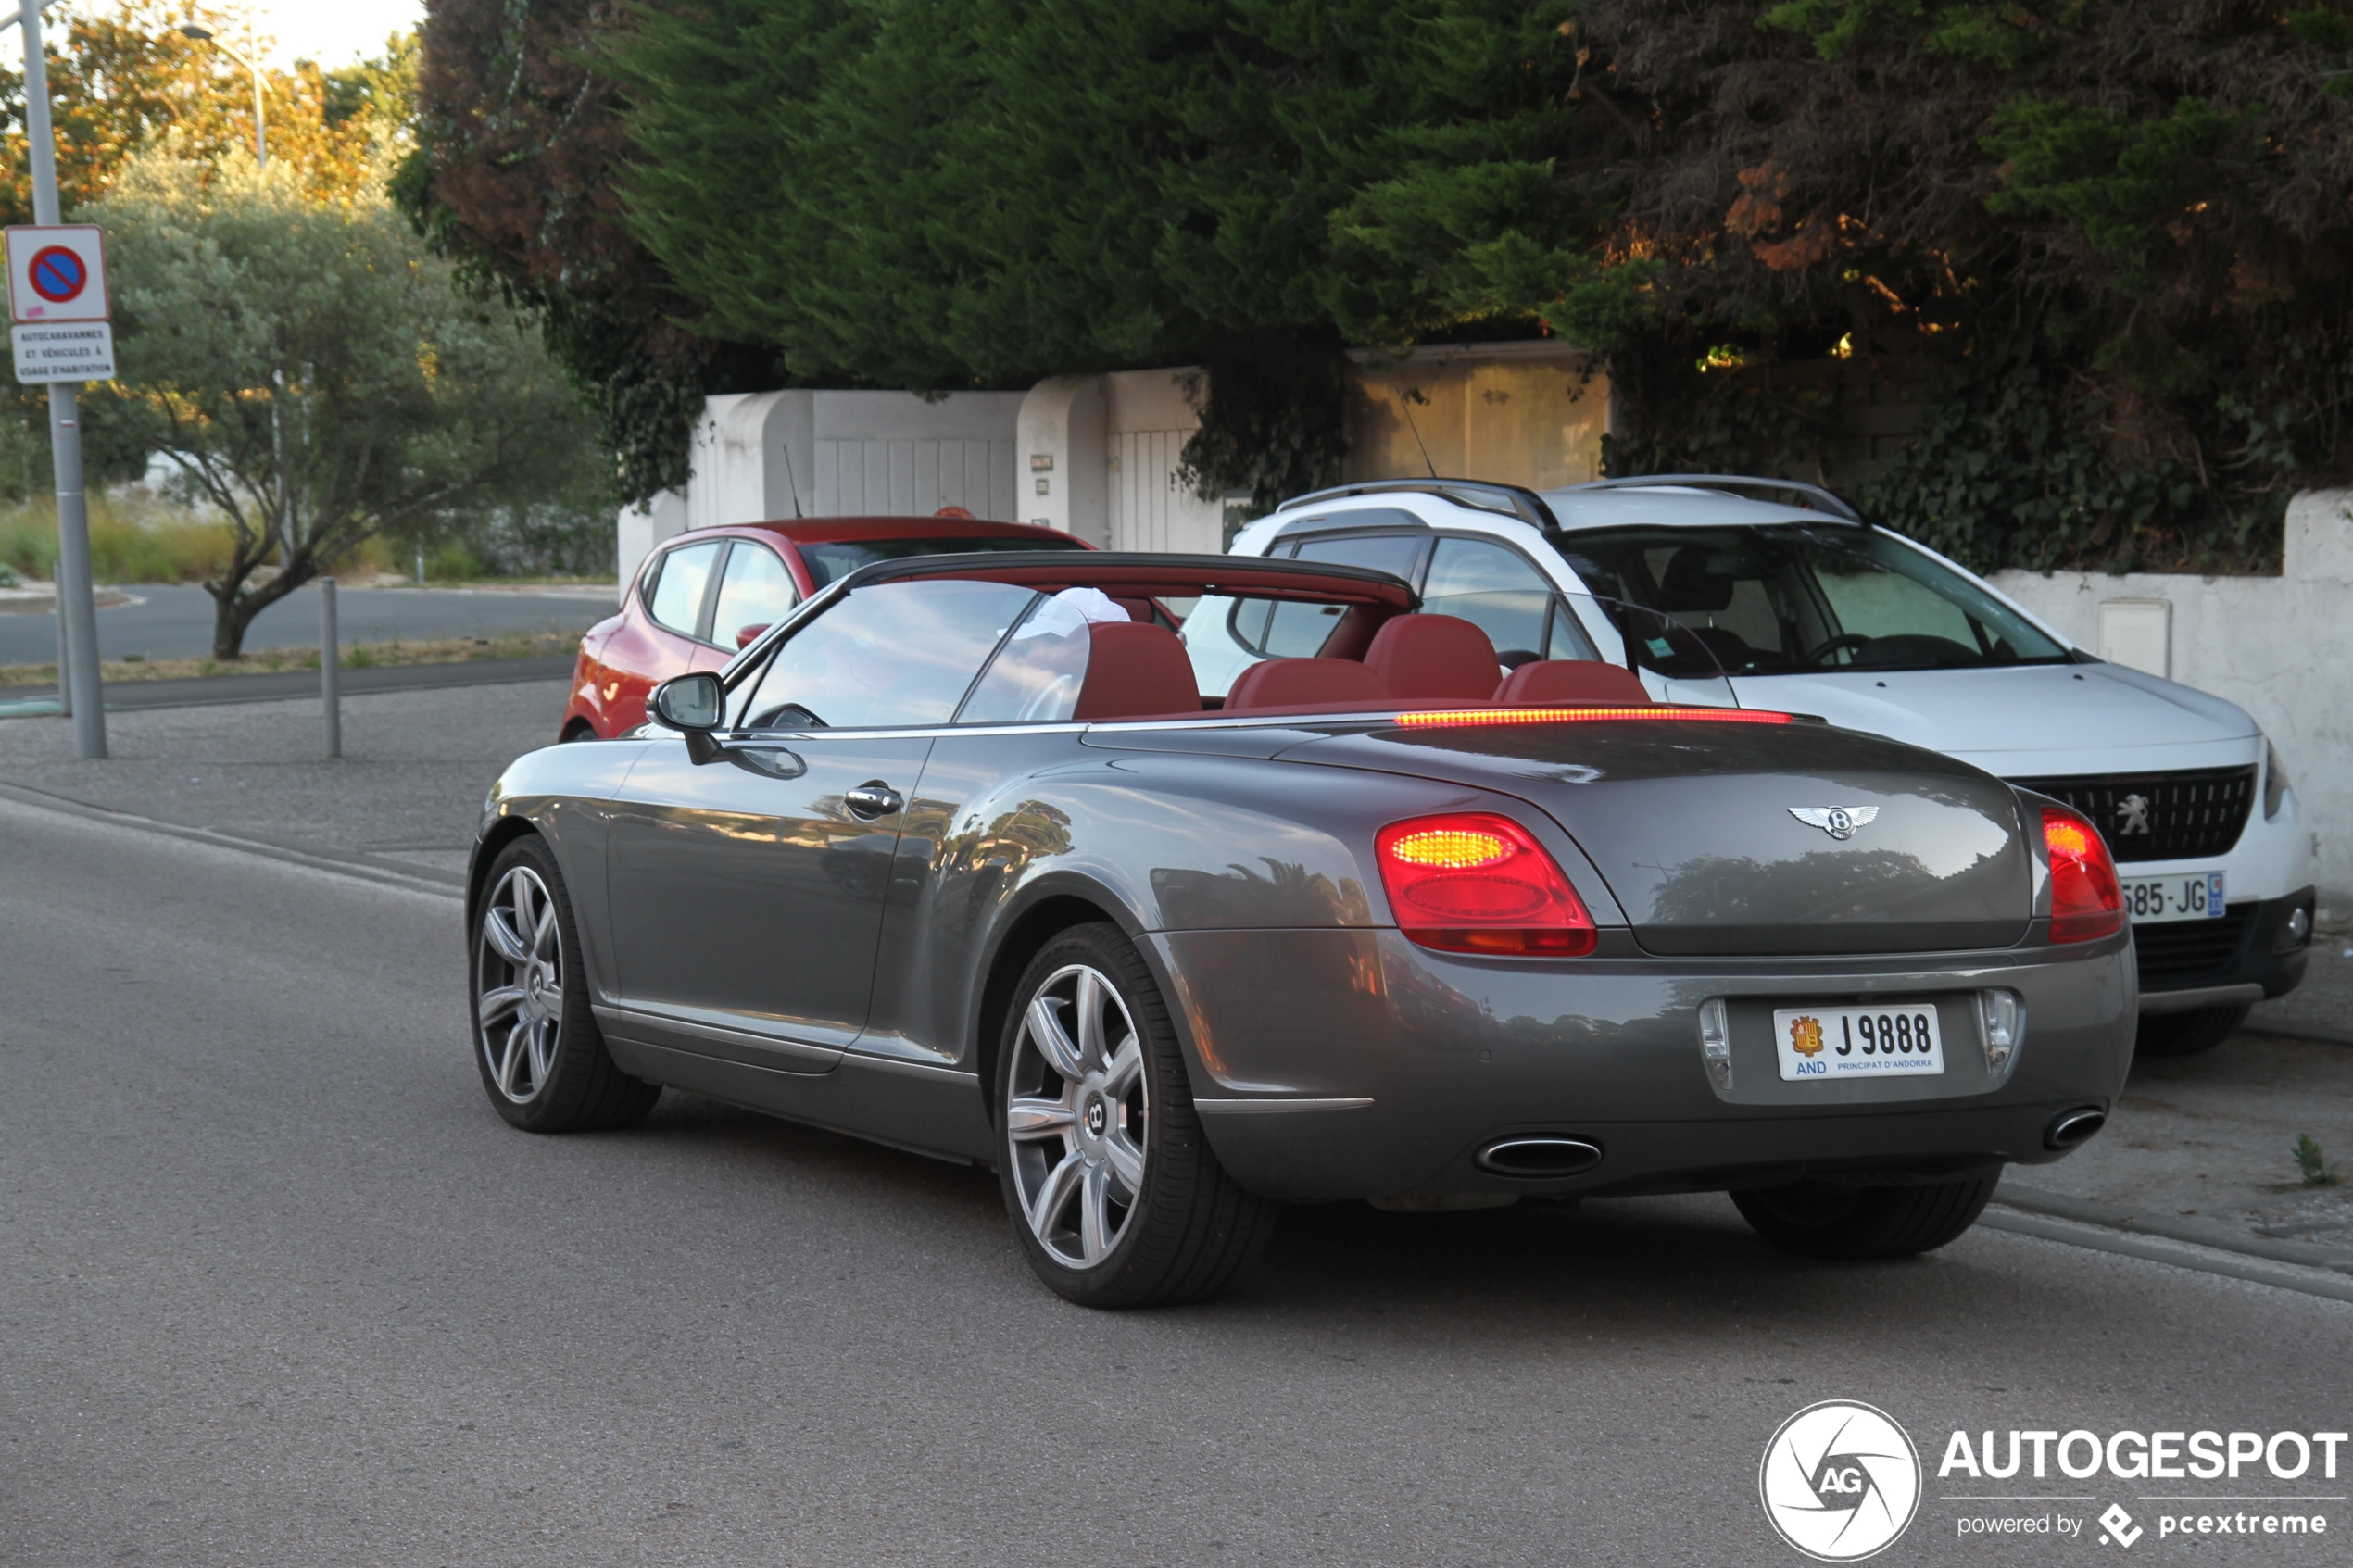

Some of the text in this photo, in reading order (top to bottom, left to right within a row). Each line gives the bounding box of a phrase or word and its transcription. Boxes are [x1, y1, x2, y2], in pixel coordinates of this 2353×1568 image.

[25, 349, 36, 359] ET
[41, 346, 91, 358] VÉHICULES
[19, 363, 111, 377] USAGE D'HABITATION
[1796, 1061, 1827, 1076] AND
[1837, 1059, 1933, 1072] PRINCIPAT D'ANDORRA
